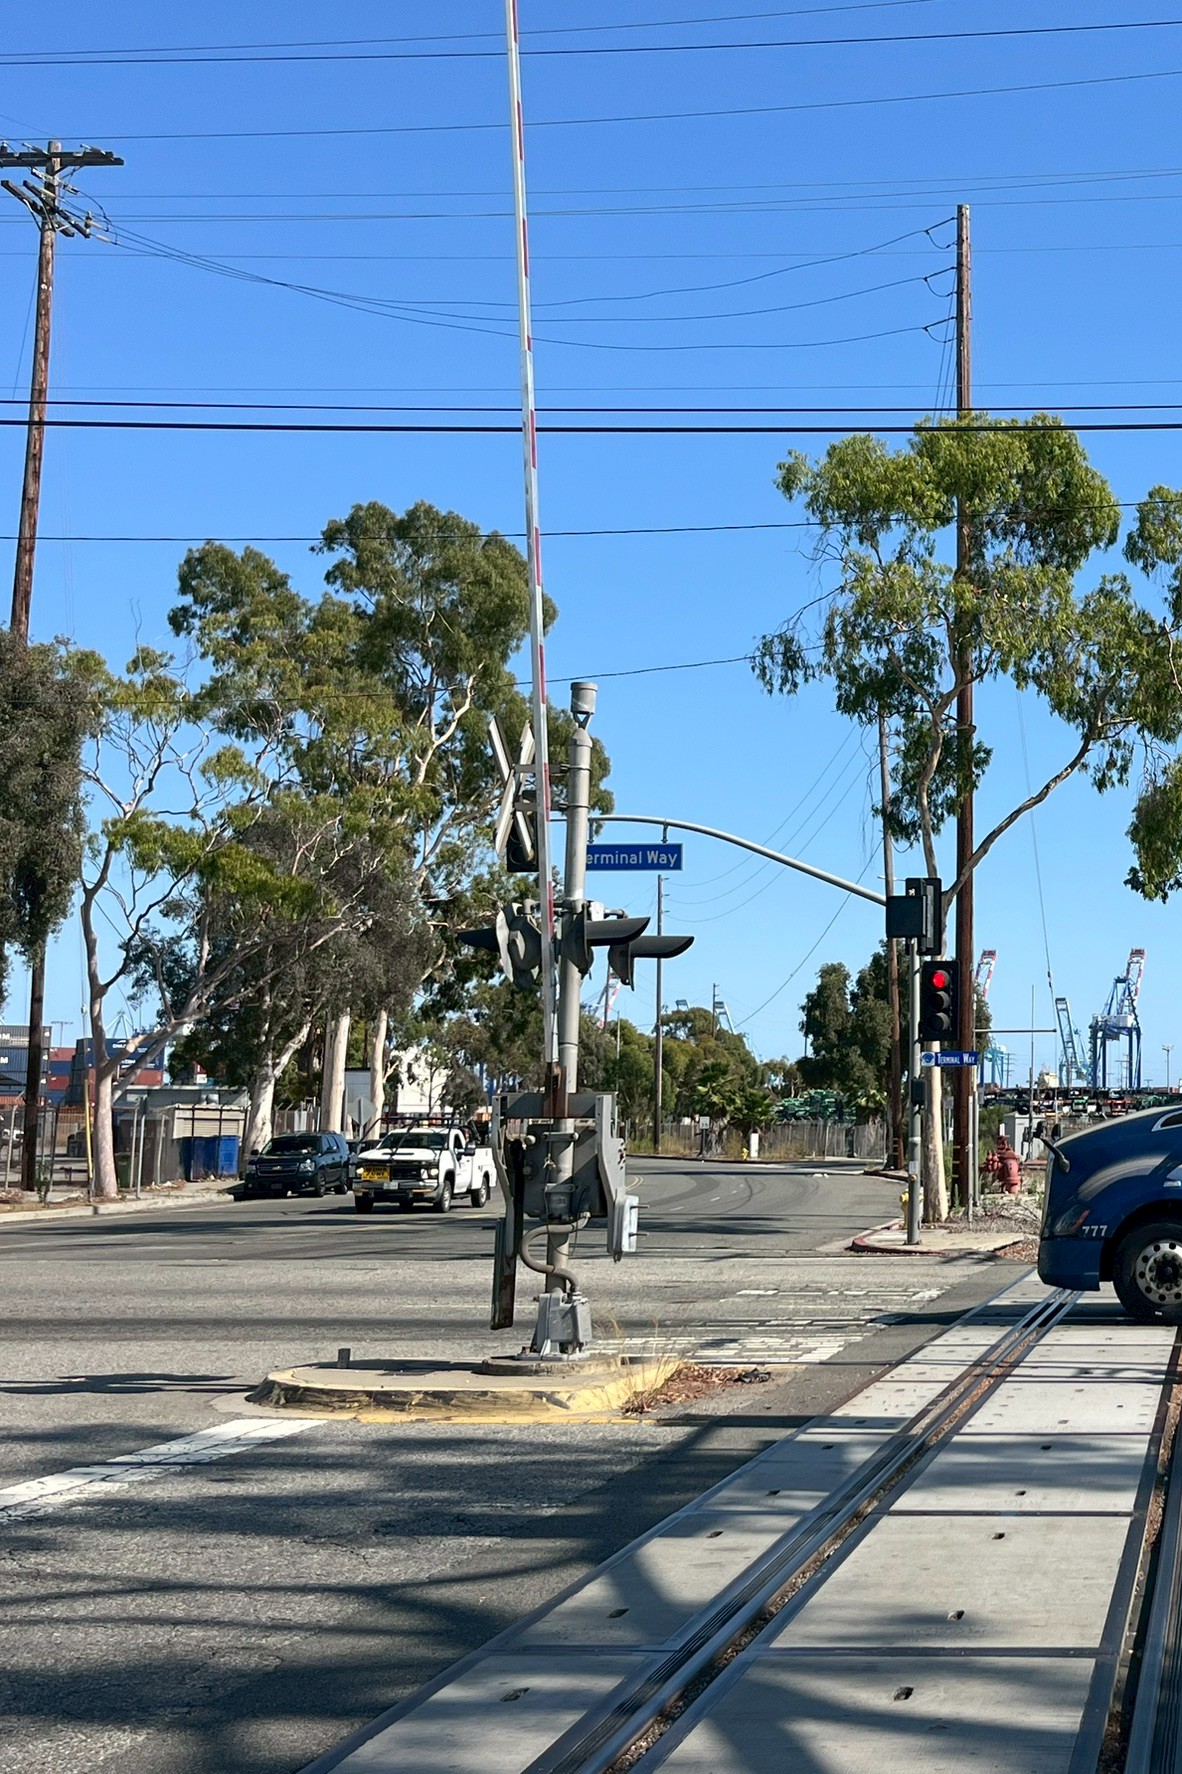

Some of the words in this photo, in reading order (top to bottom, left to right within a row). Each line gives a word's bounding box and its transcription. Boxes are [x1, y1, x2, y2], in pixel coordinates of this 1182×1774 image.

[587, 851, 642, 865] erminal
[647, 850, 678, 867] Way
[1082, 1225, 1108, 1238] 777
